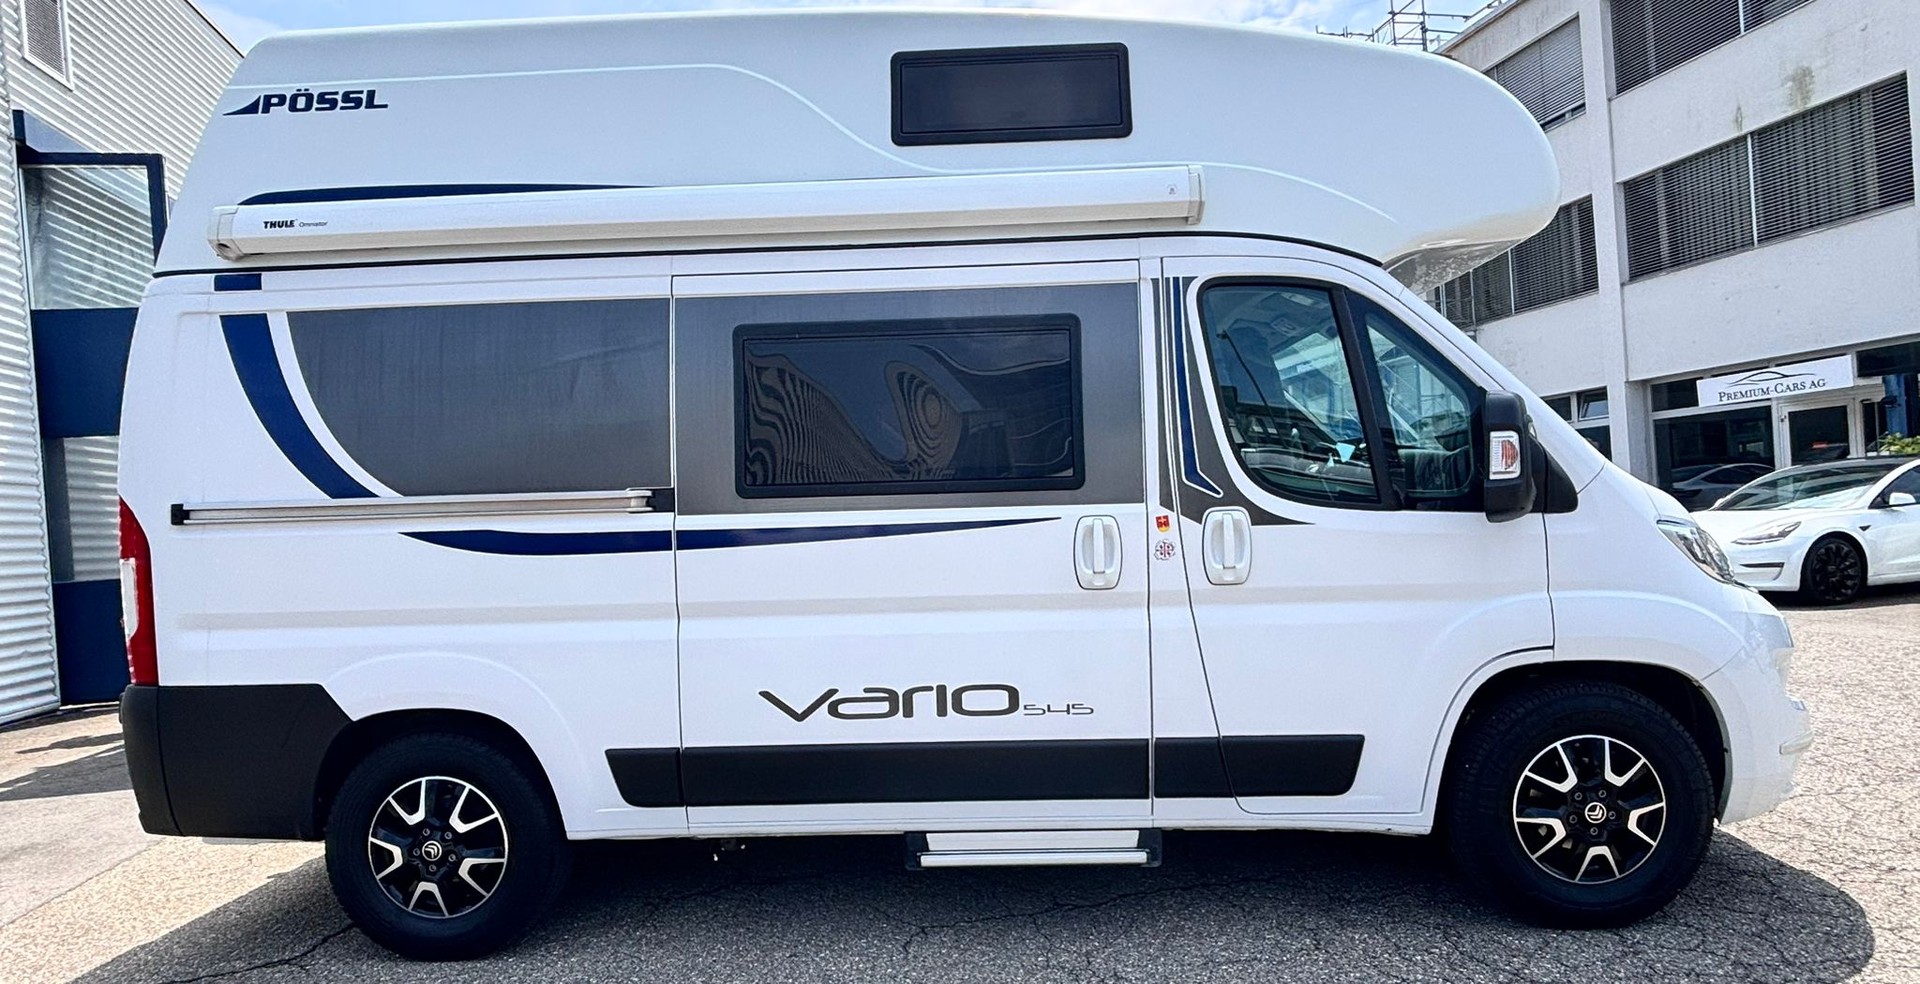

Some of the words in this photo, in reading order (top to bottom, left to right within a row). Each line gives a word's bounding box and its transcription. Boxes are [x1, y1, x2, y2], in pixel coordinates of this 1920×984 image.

[261, 88, 389, 115] PÖSSL
[263, 219, 296, 229] THULE
[1809, 378, 1826, 389] AG
[1023, 703, 1094, 716] 545
